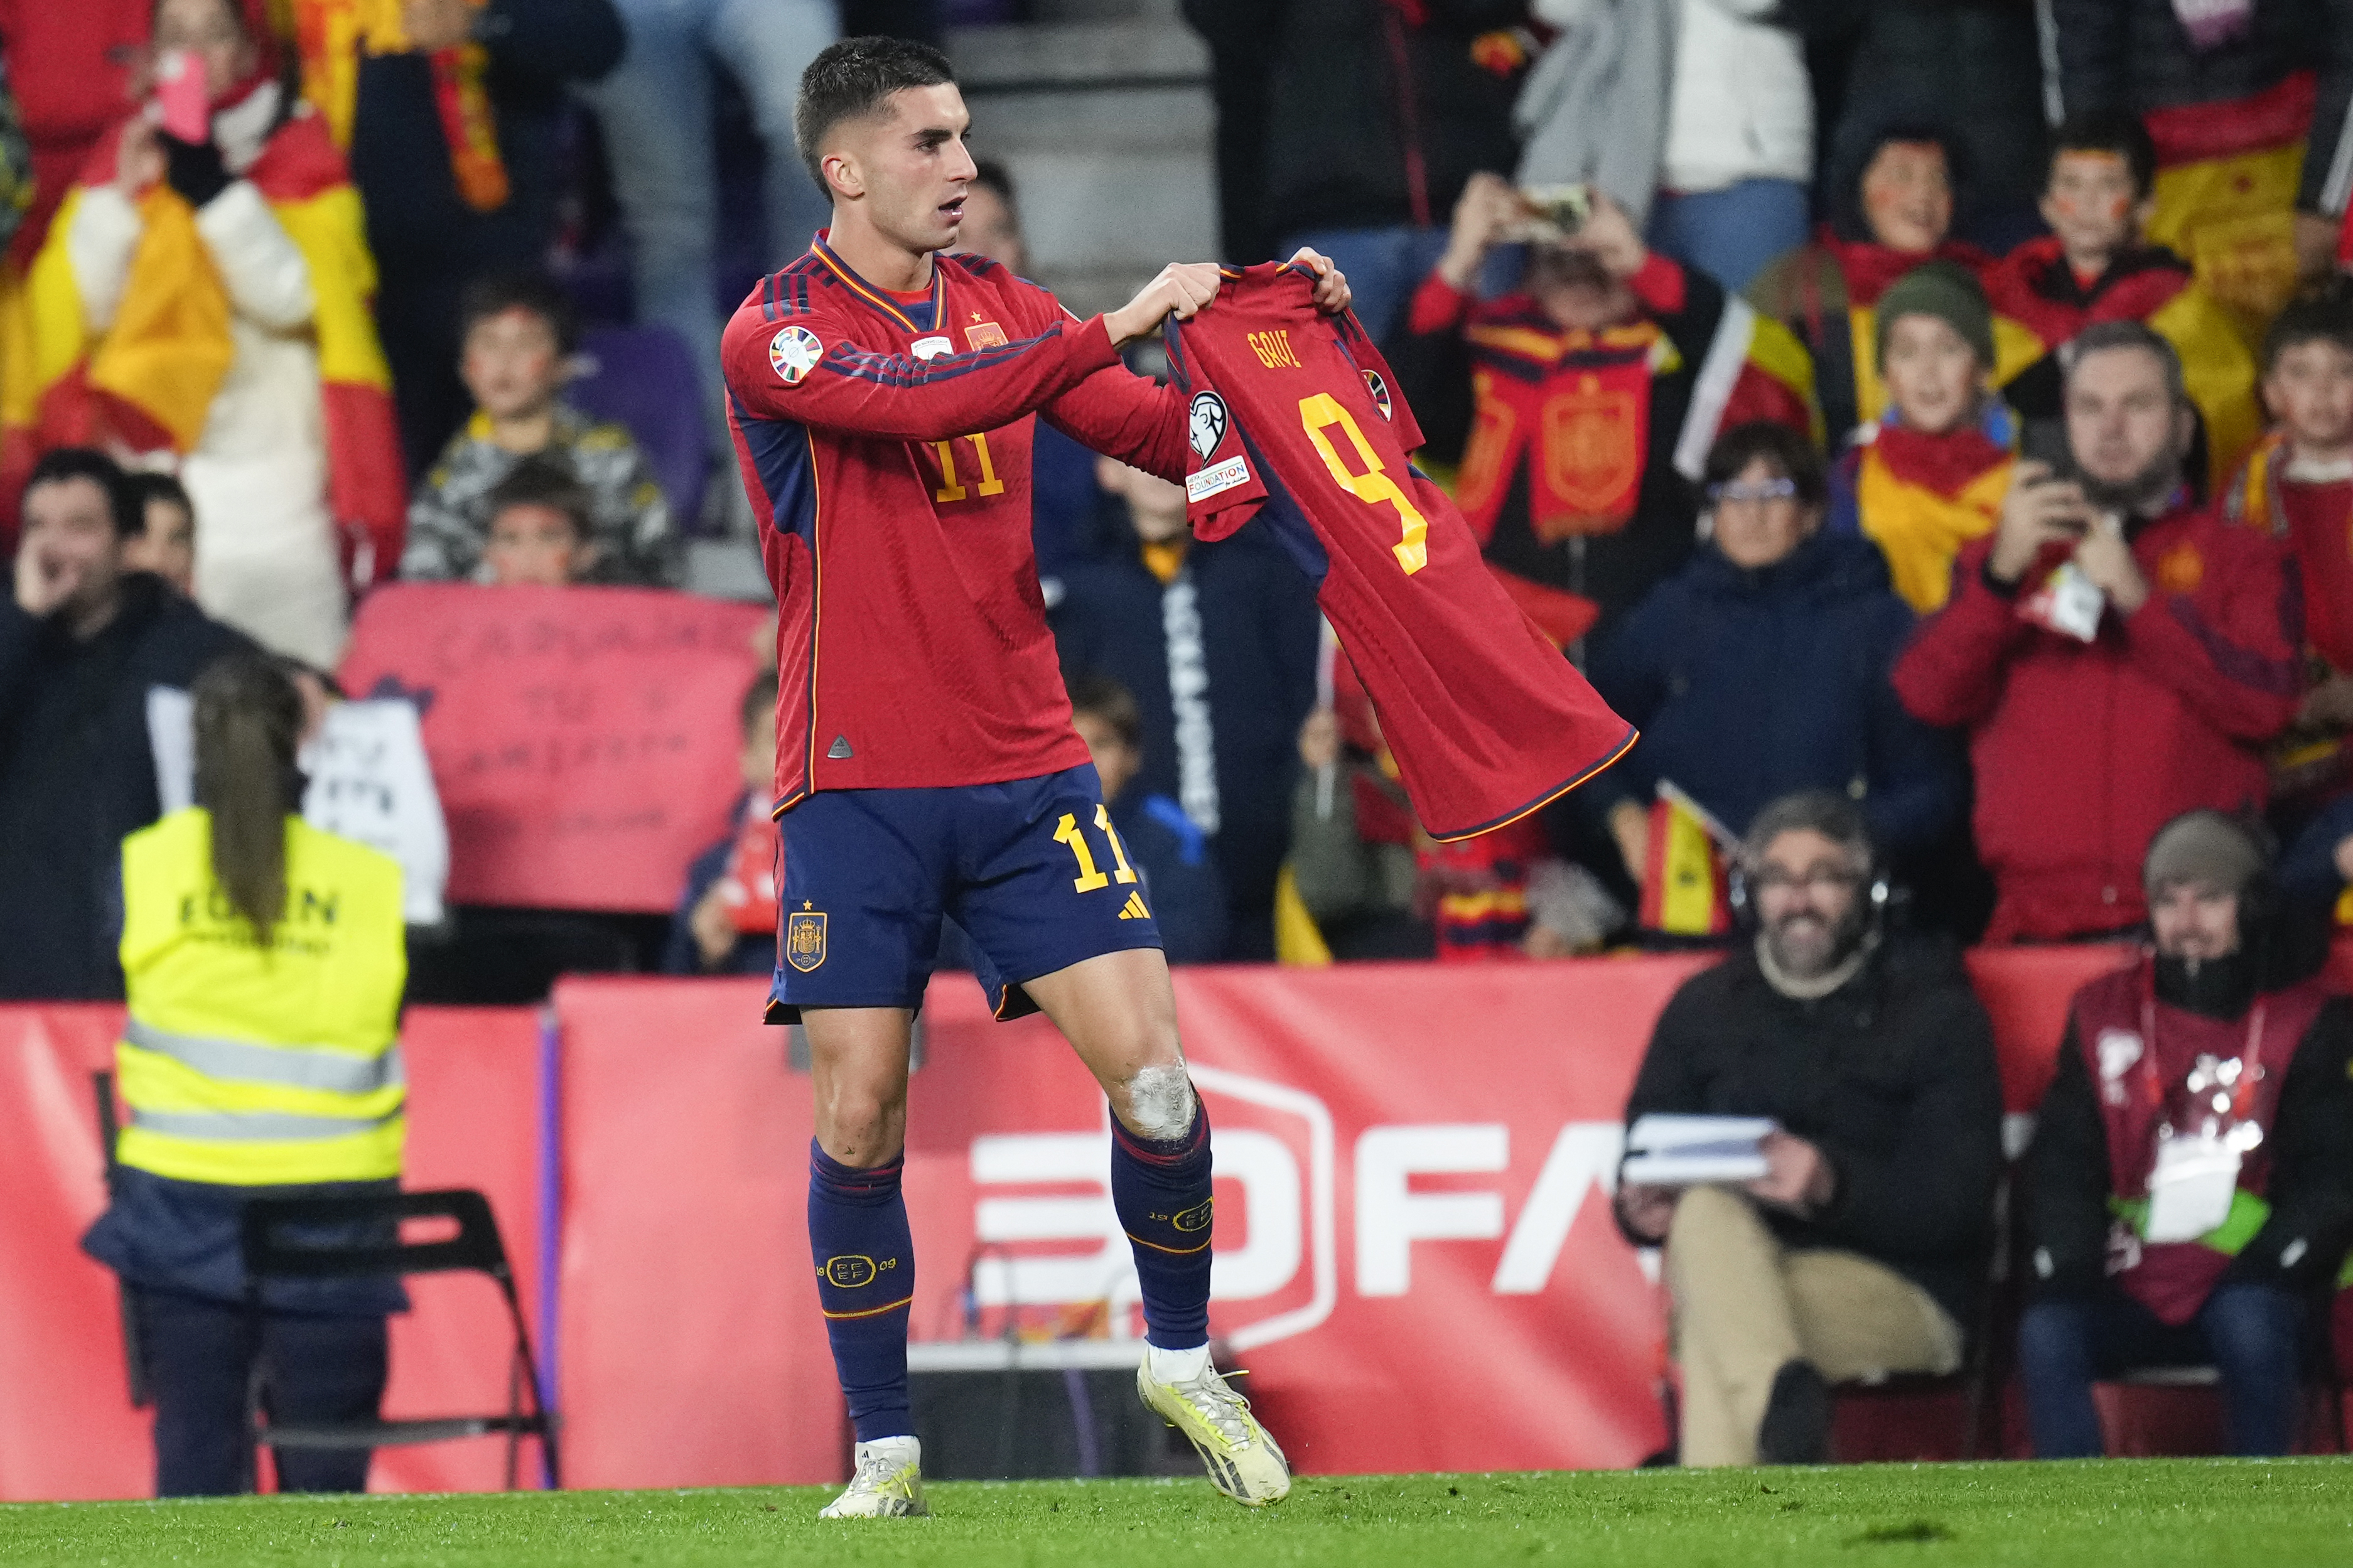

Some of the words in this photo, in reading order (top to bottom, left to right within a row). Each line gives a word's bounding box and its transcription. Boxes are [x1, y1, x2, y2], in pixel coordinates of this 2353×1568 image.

[1247, 330, 1303, 368] GAVI
[927, 432, 1004, 503] 11
[1188, 464, 1245, 493] FOUNDATION
[1298, 392, 1429, 576] 9
[1052, 803, 1138, 894] 11
